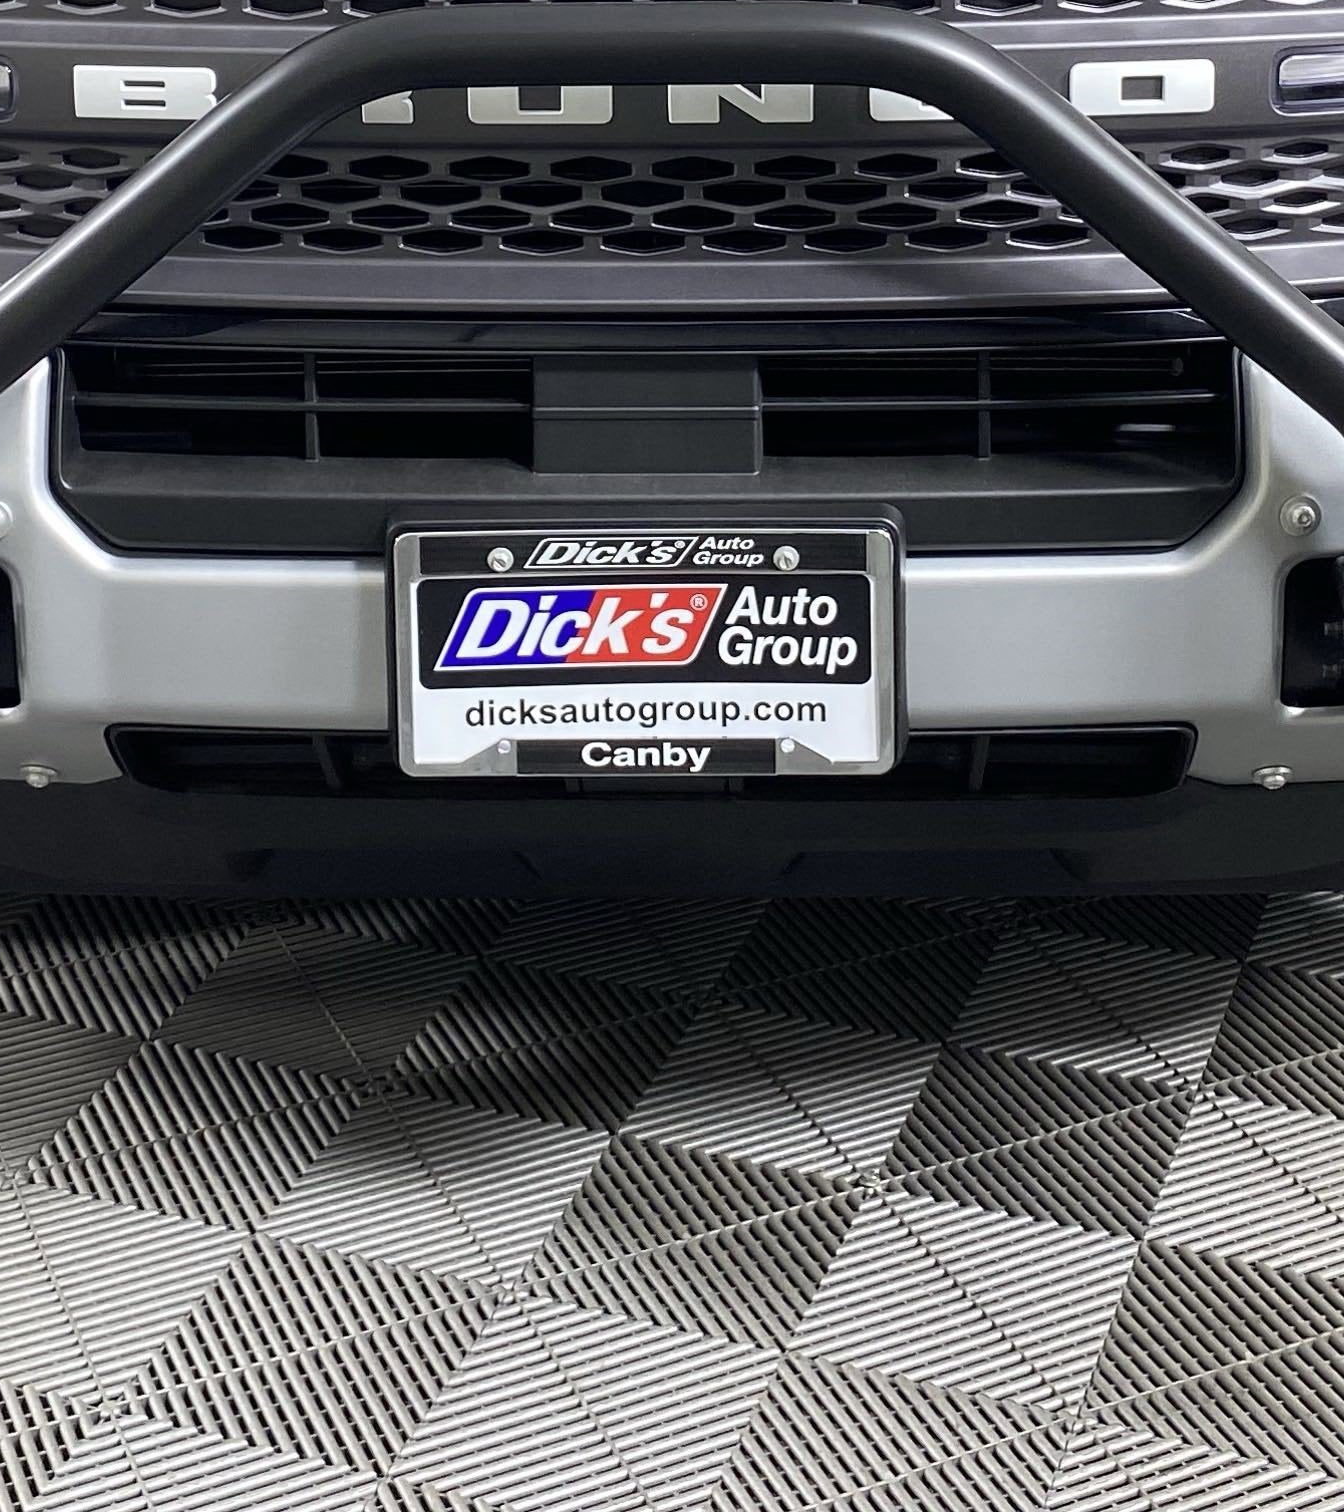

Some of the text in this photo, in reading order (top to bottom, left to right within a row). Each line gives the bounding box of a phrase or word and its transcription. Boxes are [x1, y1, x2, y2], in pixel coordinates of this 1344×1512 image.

[73, 58, 1215, 124] BONO
[698, 536, 755, 550] Auto
[692, 551, 764, 567] Group
[725, 587, 838, 626] Auto
[718, 626, 858, 675] Group
[465, 698, 827, 727] dicksautogroup.com
[581, 742, 711, 773] Canby
